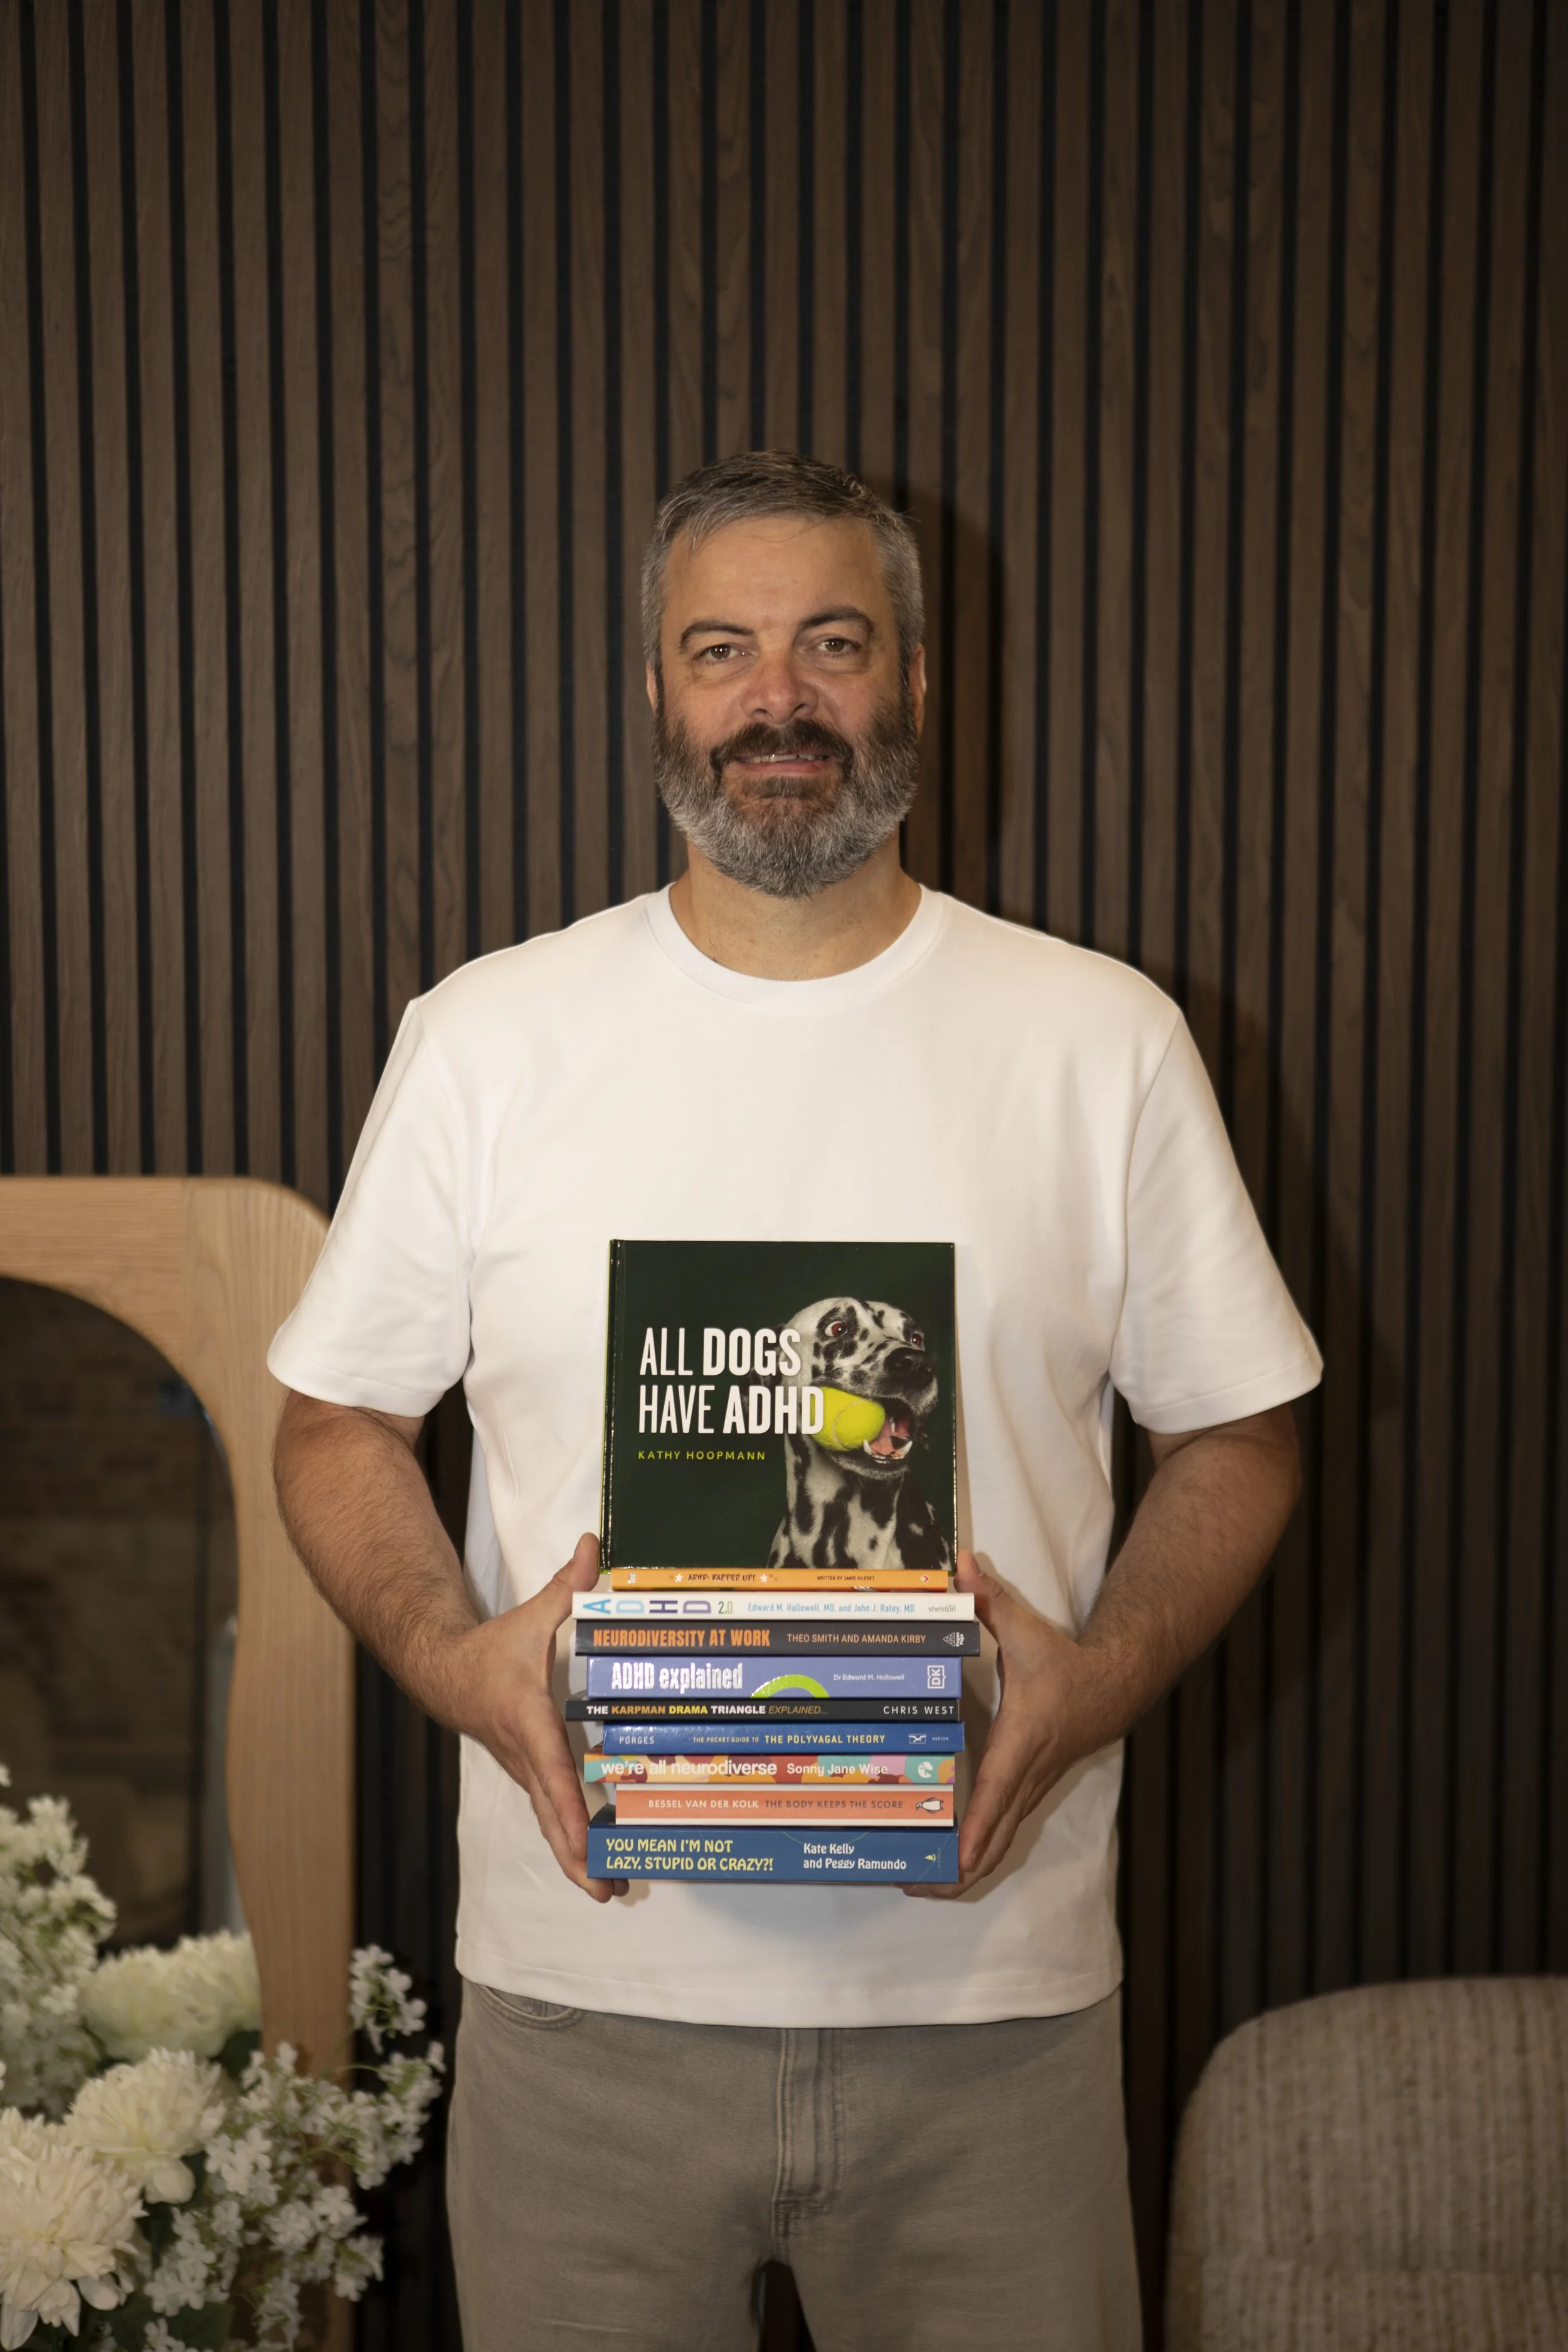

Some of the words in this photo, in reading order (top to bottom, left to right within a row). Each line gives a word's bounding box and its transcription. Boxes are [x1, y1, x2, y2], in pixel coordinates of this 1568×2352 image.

[640, 1327, 693, 1376] ALL
[703, 1328, 801, 1377] DOGS
[638, 1385, 715, 1434] HAVE
[723, 1385, 824, 1434] ADHD
[638, 1450, 681, 1461] KATHY
[686, 1451, 766, 1461] HOOPMANN
[712, 1574, 739, 1582] RAPPED
[743, 1574, 755, 1582] UP!
[718, 1601, 733, 1614] 2.0
[748, 1603, 774, 1612] Edward
[776, 1604, 784, 1612] M.
[839, 1604, 851, 1613] and
[854, 1604, 869, 1613] John
[872, 1604, 878, 1613] J.
[904, 1604, 914, 1613] MD
[593, 1629, 705, 1647] NEURODIVERSITY
[709, 1629, 726, 1647] AT
[730, 1629, 770, 1647] WORK
[787, 1634, 810, 1643] THEO
[812, 1634, 839, 1643] SMITH
[840, 1634, 859, 1643] AND
[861, 1634, 899, 1644] AMANDA
[901, 1634, 926, 1644] KIRBY
[612, 1662, 655, 1690] ADHD
[659, 1662, 743, 1694] explained
[931, 1668, 941, 1686] DK
[586, 1705, 608, 1715] THE
[612, 1705, 665, 1715] KARPMAN
[669, 1705, 708, 1715] DRAMA
[711, 1705, 766, 1715] TRIANGLE
[768, 1705, 828, 1715] EXPLAINED...
[883, 1706, 918, 1715] CHRIS
[924, 1706, 954, 1715] WEST
[619, 1736, 654, 1745] PORGES
[765, 1735, 783, 1744] THE
[787, 1735, 843, 1744] POLYVAGAL
[847, 1735, 886, 1744] THEORY
[601, 1761, 644, 1776] we're
[649, 1760, 667, 1776] all
[671, 1760, 777, 1776] neurodiverse
[787, 1763, 824, 1777] Sonny
[827, 1763, 856, 1774] Jane
[859, 1763, 887, 1775] Wise
[649, 1800, 682, 1808] BESSEL
[686, 1800, 707, 1808] VAN
[711, 1800, 729, 1808] DER
[733, 1800, 758, 1808] KOLK
[606, 1838, 634, 1851] YOU
[637, 1839, 676, 1852] MEAN
[681, 1839, 701, 1853] I'M
[704, 1840, 733, 1853] NOT
[803, 1843, 827, 1855] Kate
[829, 1843, 854, 1856] Kelly
[606, 1857, 642, 1870] LAZY,
[645, 1857, 694, 1870] STUPID
[697, 1858, 717, 1870] OR
[719, 1858, 773, 1871] CRAZY?!
[803, 1858, 822, 1869] and
[825, 1858, 855, 1870] Peggy
[857, 1858, 907, 1870] Ramundo
